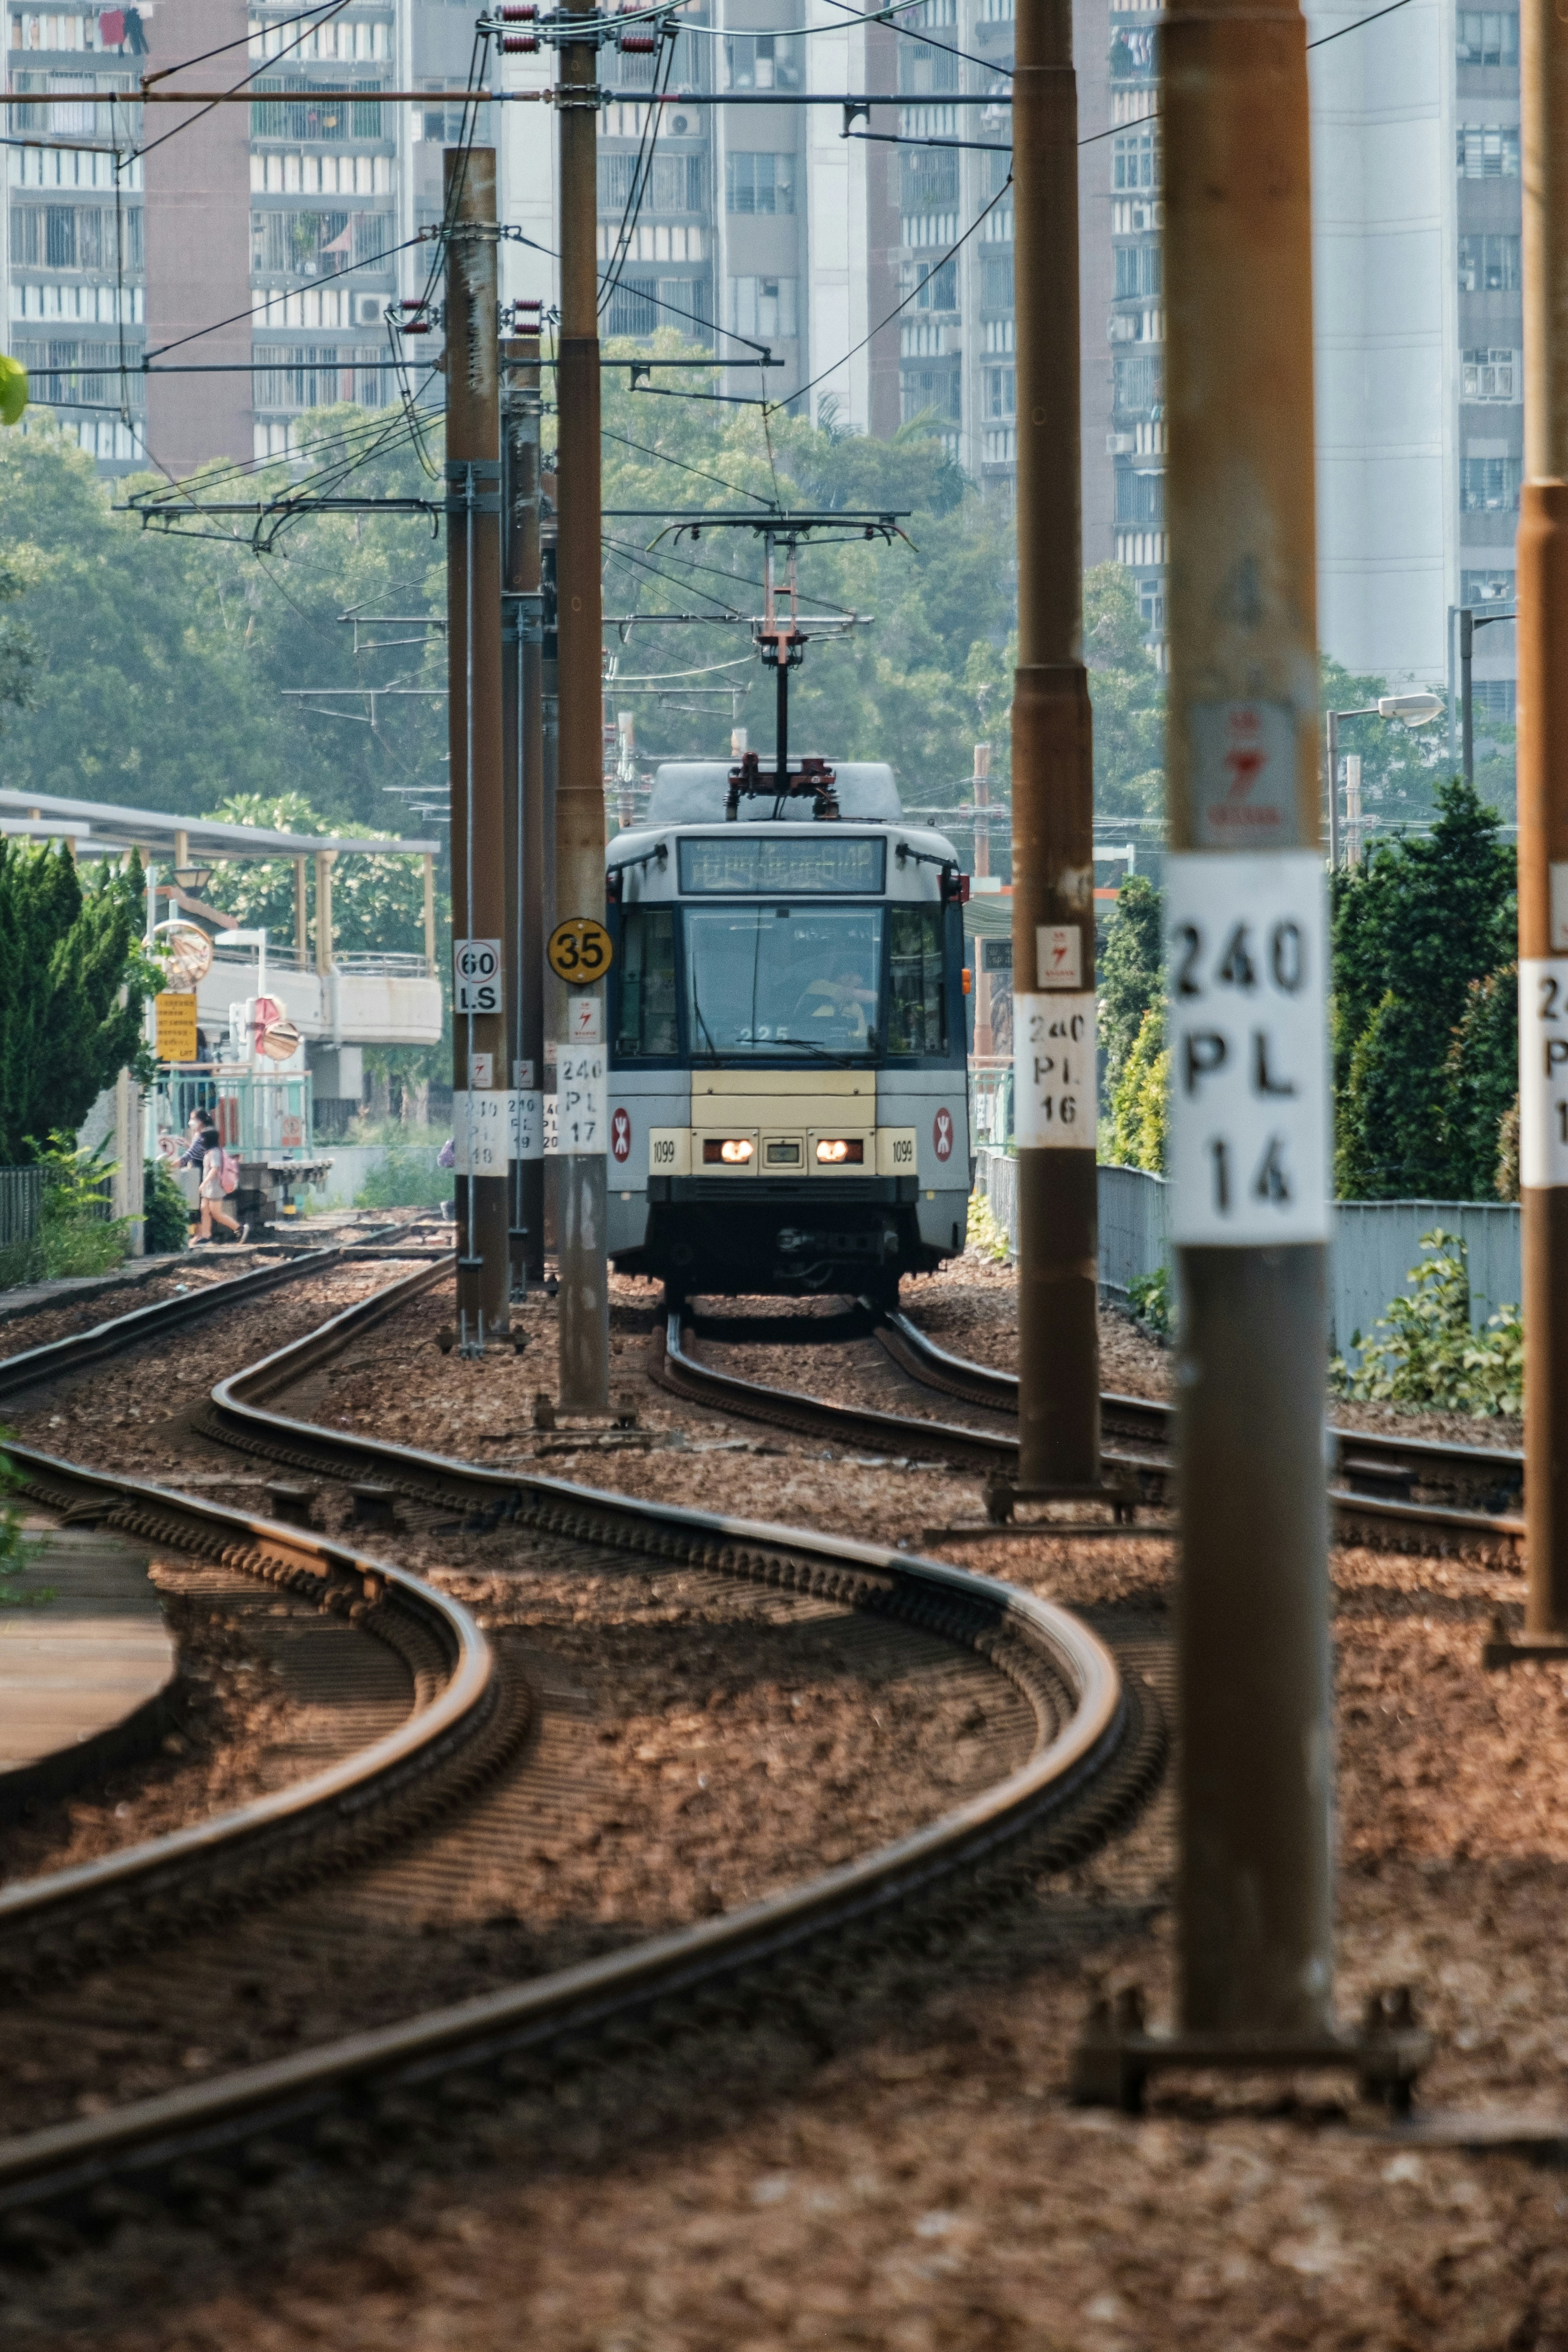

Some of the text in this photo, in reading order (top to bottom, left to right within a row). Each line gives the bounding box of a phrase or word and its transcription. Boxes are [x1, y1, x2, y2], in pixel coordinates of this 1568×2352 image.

[556, 933, 603, 970] 35
[1172, 918, 1309, 1004] 240
[462, 953, 494, 975] 60
[461, 986, 495, 1009] LS
[1538, 977, 1568, 1022] 2
[563, 1060, 602, 1080] 240
[1180, 1030, 1296, 1099] PL
[567, 1092, 596, 1112] PL
[1042, 1094, 1076, 1124] 16
[571, 1122, 595, 1143] 17
[654, 1141, 674, 1163] 1099
[893, 1140, 912, 1162] 1099
[1209, 1131, 1291, 1218] 14
